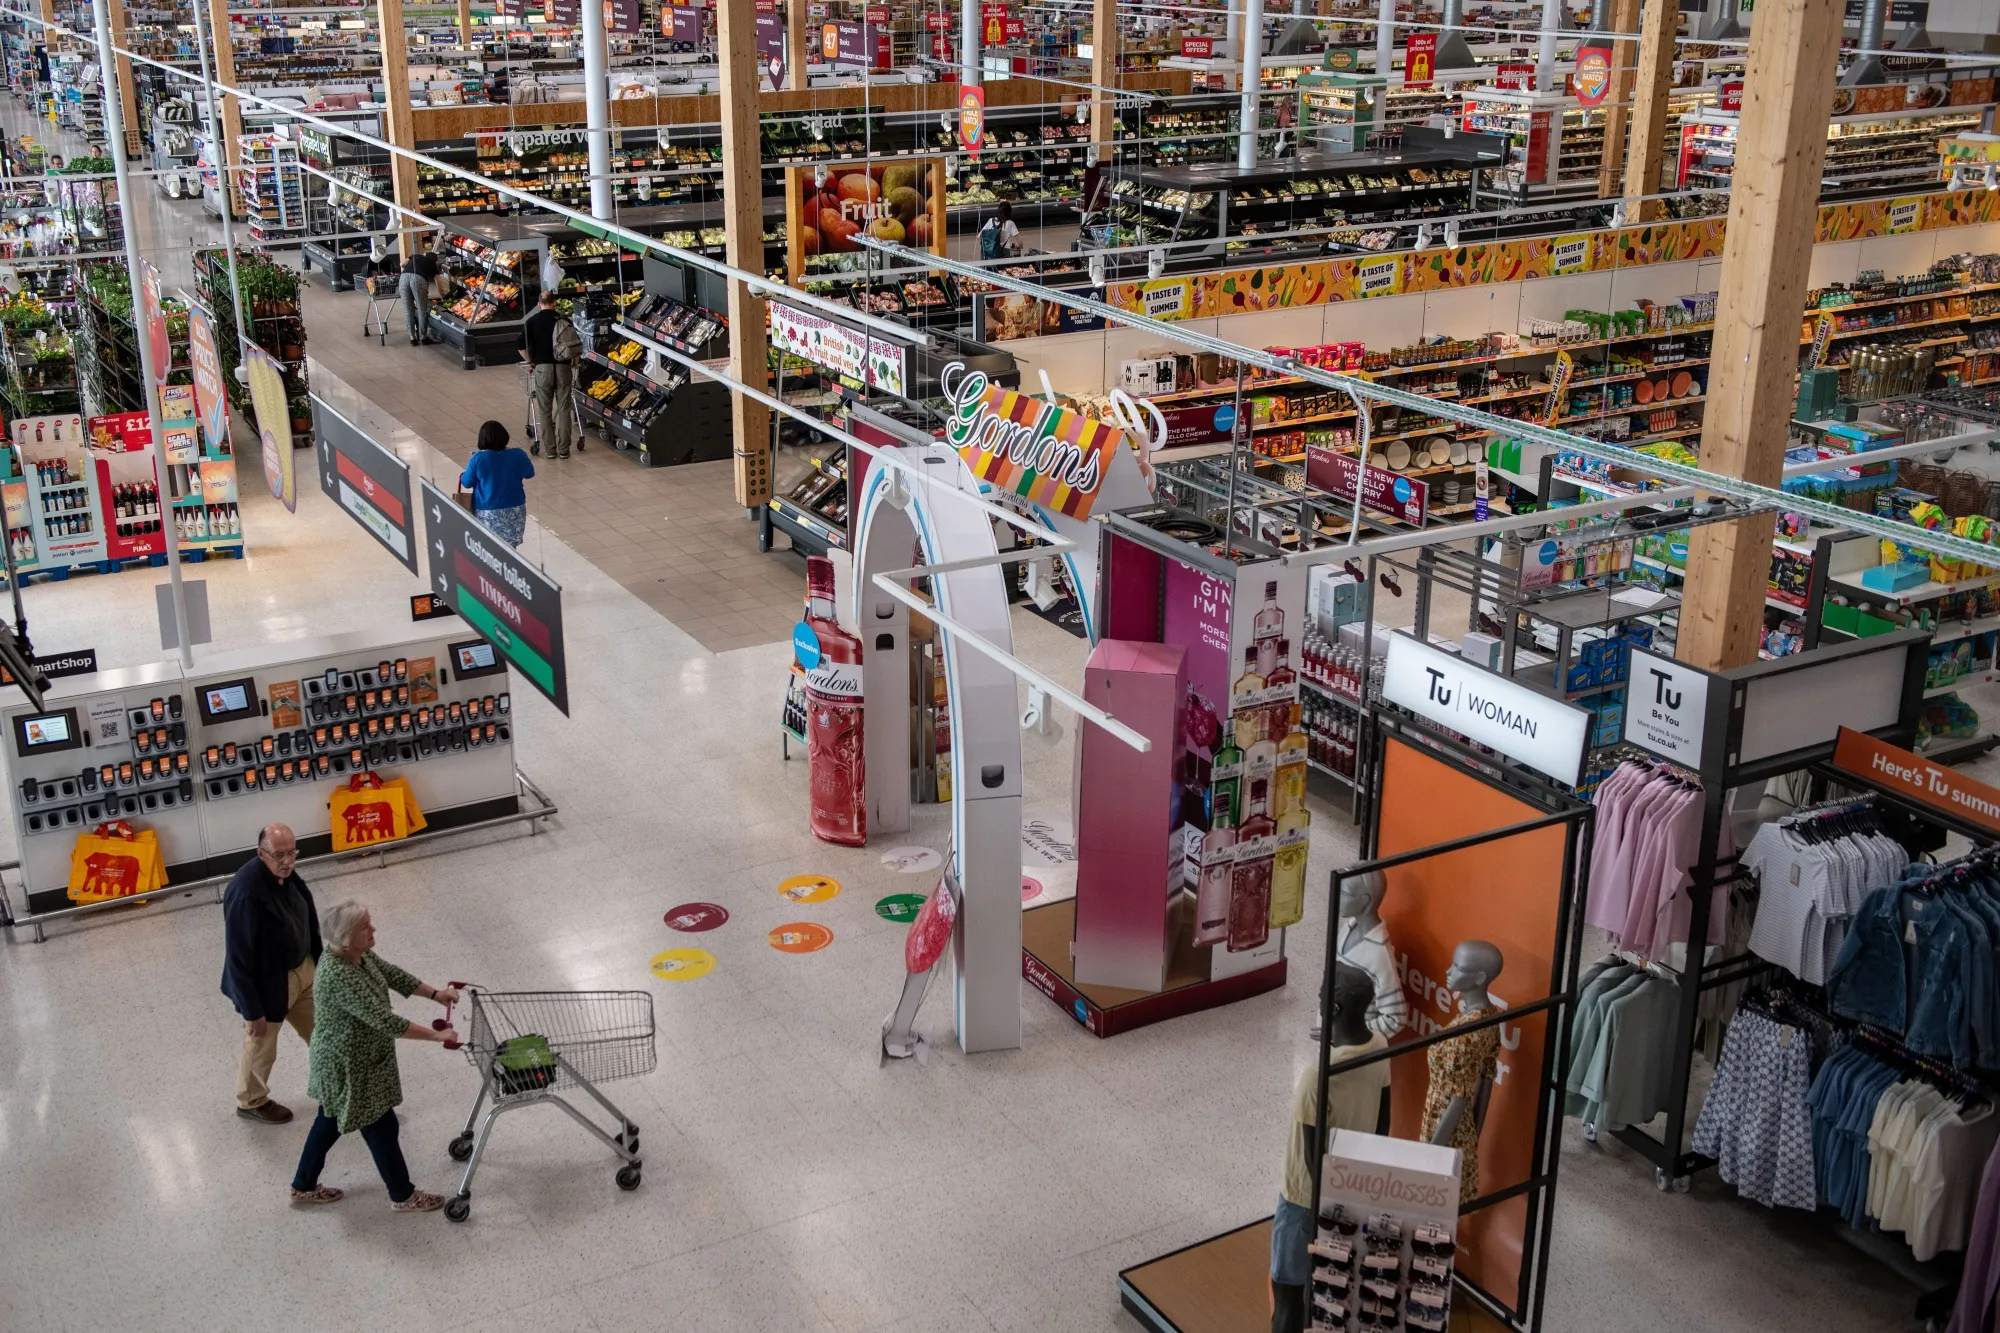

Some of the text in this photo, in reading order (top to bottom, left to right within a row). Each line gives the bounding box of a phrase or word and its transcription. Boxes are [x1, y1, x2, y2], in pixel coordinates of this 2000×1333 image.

[662, 14, 672, 30] 45
[824, 32, 836, 50] 47
[840, 38, 850, 46] Books
[1887, 56, 1929, 66] CHARCUTERIE
[1582, 74, 1604, 82] MATCH
[840, 198, 893, 222] Fruit
[1896, 206, 1910, 214] TASTE
[1910, 204, 1916, 212] OF
[1894, 216, 1913, 226] SUMMER
[1556, 242, 1585, 256] A TASTE OF
[1368, 266, 1385, 276] TASTE
[1386, 263, 1394, 271] OF
[1559, 256, 1582, 267] SUMMER
[1366, 277, 1391, 289] SUMMER
[1146, 286, 1181, 302] A TASTE OF
[1150, 302, 1179, 315] SUMMER
[823, 335, 844, 352] British
[194, 340, 216, 375] PRICE
[814, 345, 853, 372] fruit and veg
[196, 368, 218, 397] MATCH
[1554, 368, 1563, 386] TASTE
[166, 387, 184, 396] FREE
[1553, 385, 1558, 394] OF
[1545, 393, 1555, 420] SUMMER
[167, 434, 186, 443] SCAN
[174, 438, 192, 448] HERE
[1336, 459, 1394, 484] TRY TE NEW
[1344, 471, 1385, 491] MOELLO
[1364, 498, 1394, 512] DECISIONS
[133, 544, 152, 553] PIMM'S
[464, 531, 532, 600] Customer toilets
[479, 576, 521, 625] TIMPSON
[1201, 581, 1231, 606] GIN
[1194, 595, 1216, 618] I'M
[1200, 621, 1229, 642] MOREL
[795, 638, 818, 655] Exclusive
[36, 658, 92, 672] martShop
[1650, 668, 1682, 710] Tu
[1426, 666, 1537, 739] Tu WOMAN
[1652, 709, 1679, 727] Be You
[1638, 719, 1650, 729] More
[1651, 725, 1664, 735] styles
[1670, 734, 1683, 743] sizes
[1648, 733, 1676, 750] tu.co.uk
[1872, 752, 2000, 819] Here's Tu summ
[1330, 1164, 1448, 1208] Sunglasses
